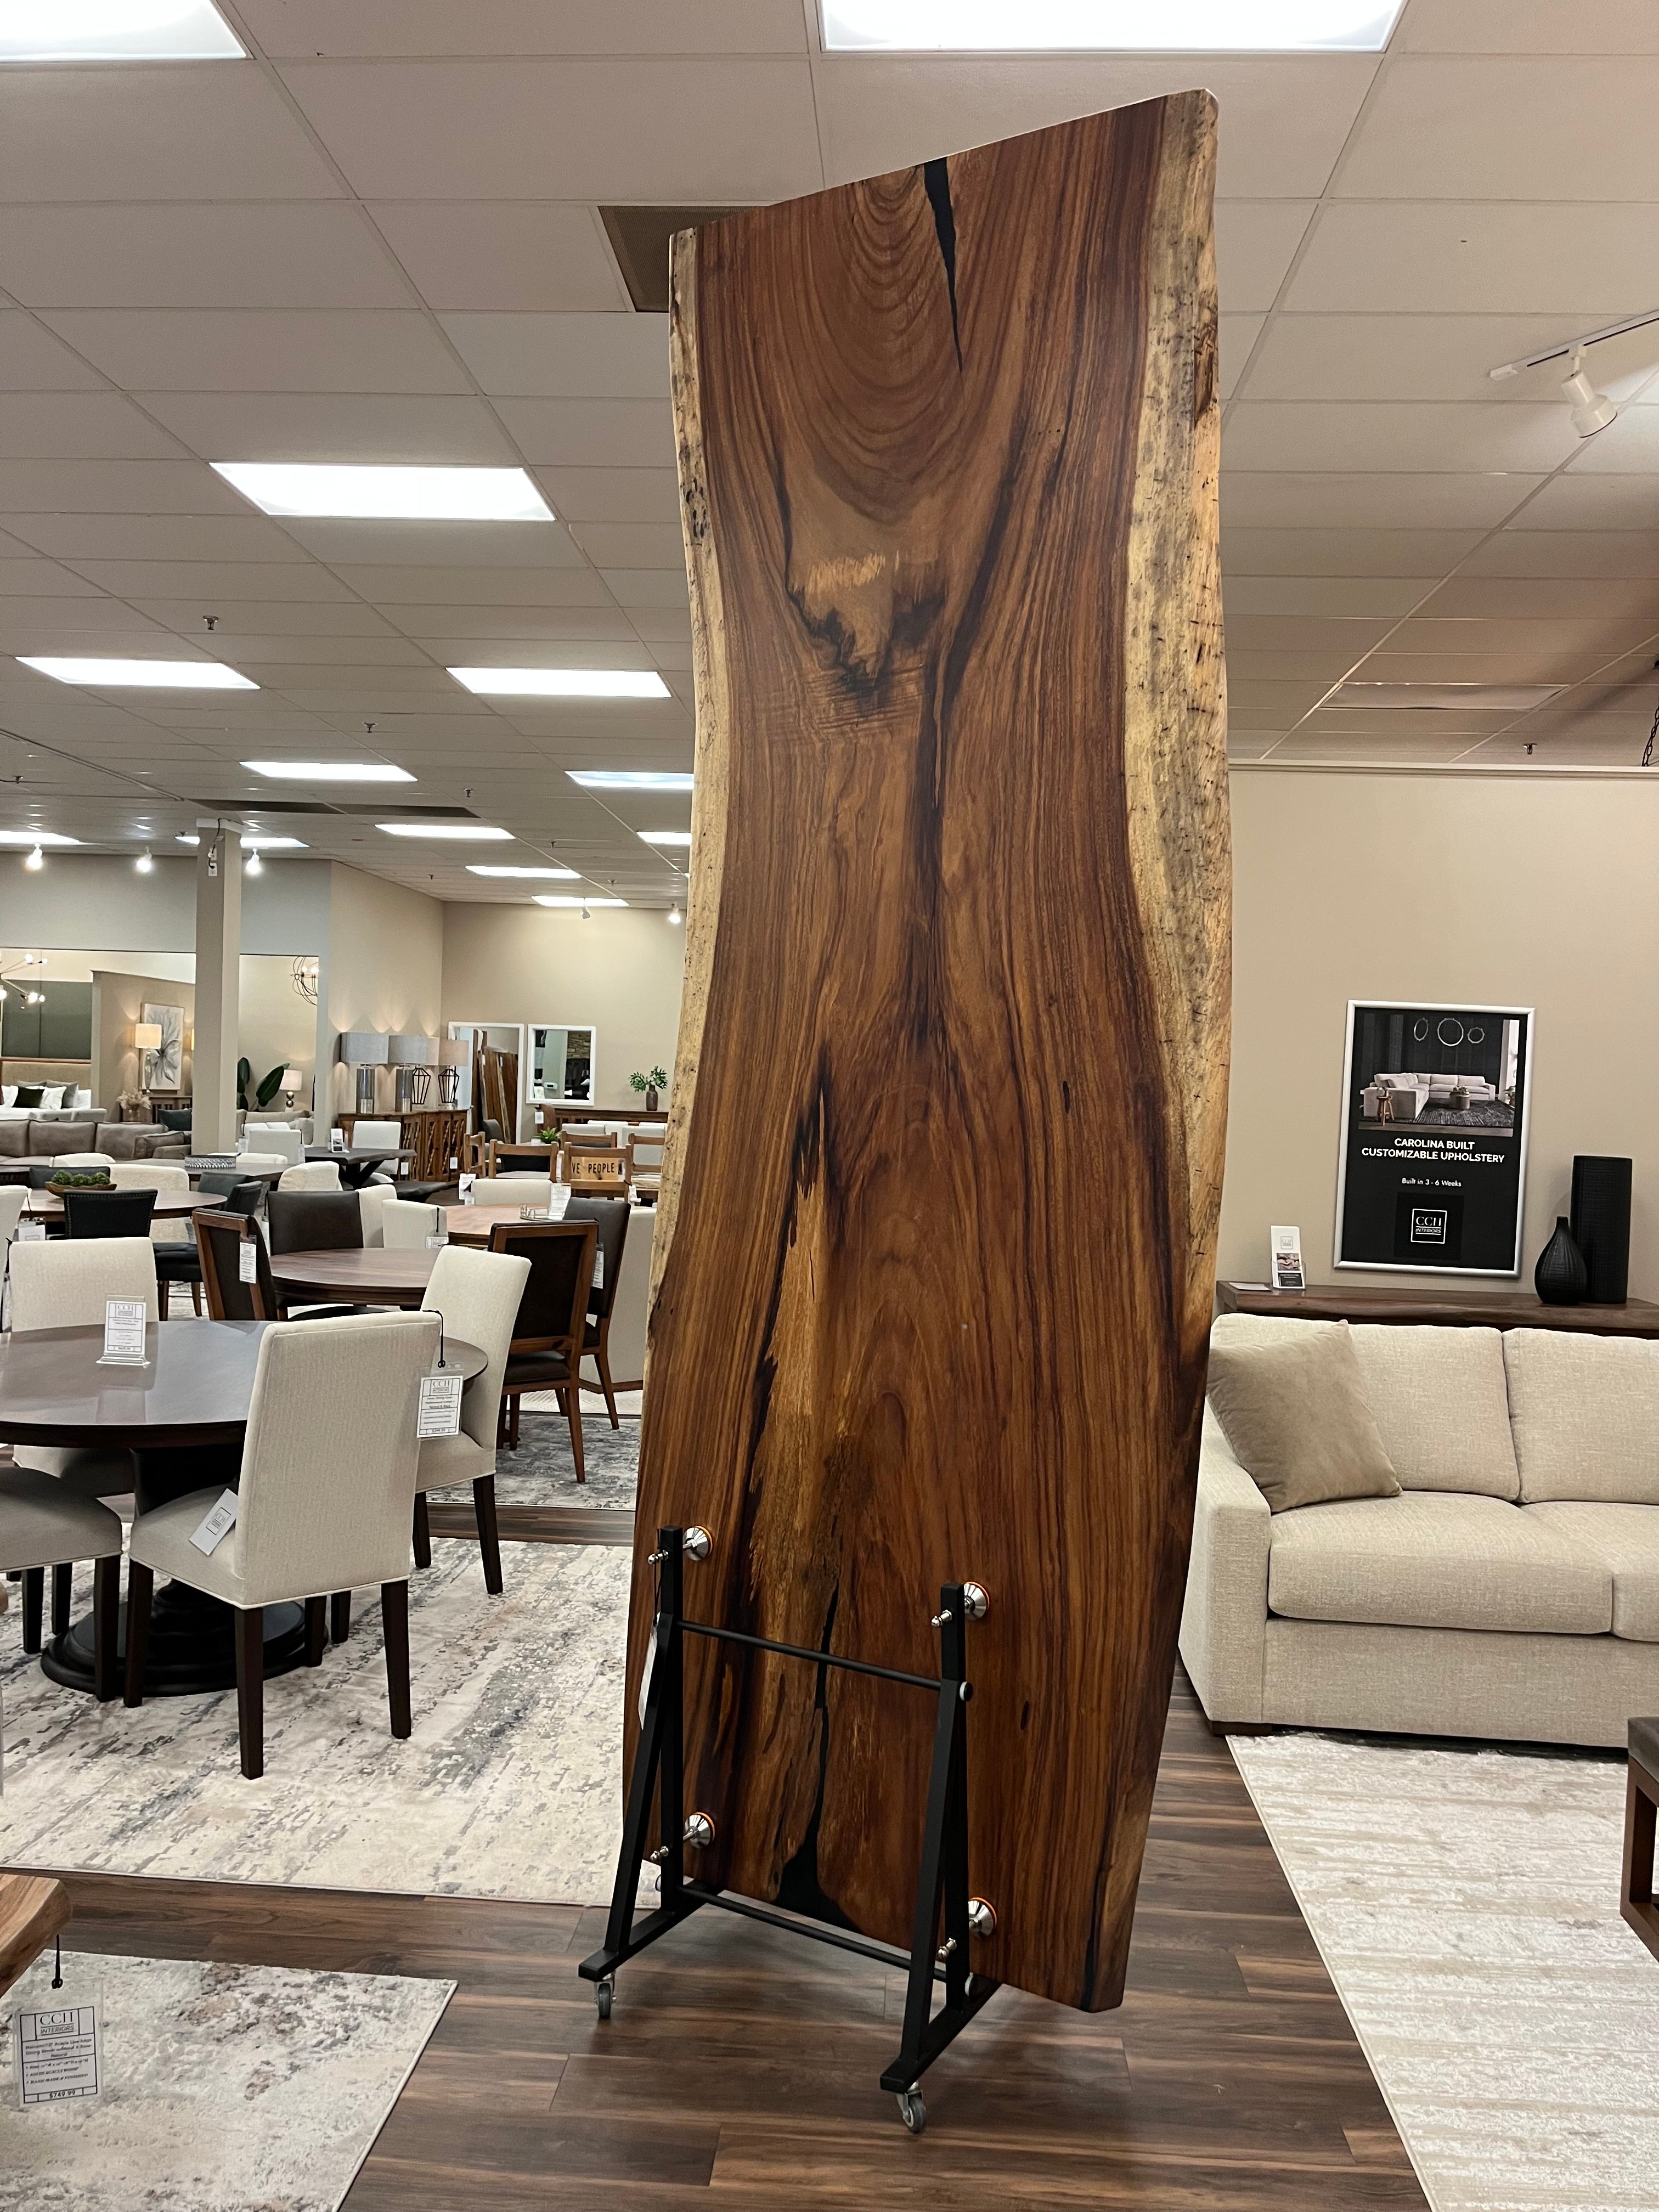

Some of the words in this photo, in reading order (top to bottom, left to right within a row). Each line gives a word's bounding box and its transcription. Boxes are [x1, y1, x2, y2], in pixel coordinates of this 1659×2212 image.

[1394, 1138, 1444, 1148] CAROLINA
[1446, 1141, 1475, 1150] BUILT
[1361, 1148, 1438, 1160] CUSTOMIZABLE
[1440, 1152, 1505, 1163] UPHOLSTERY
[588, 1163, 614, 1173] PEOPLE
[40, 2012, 72, 2025] CCH
[41, 2025, 74, 2034] INTERIORS
